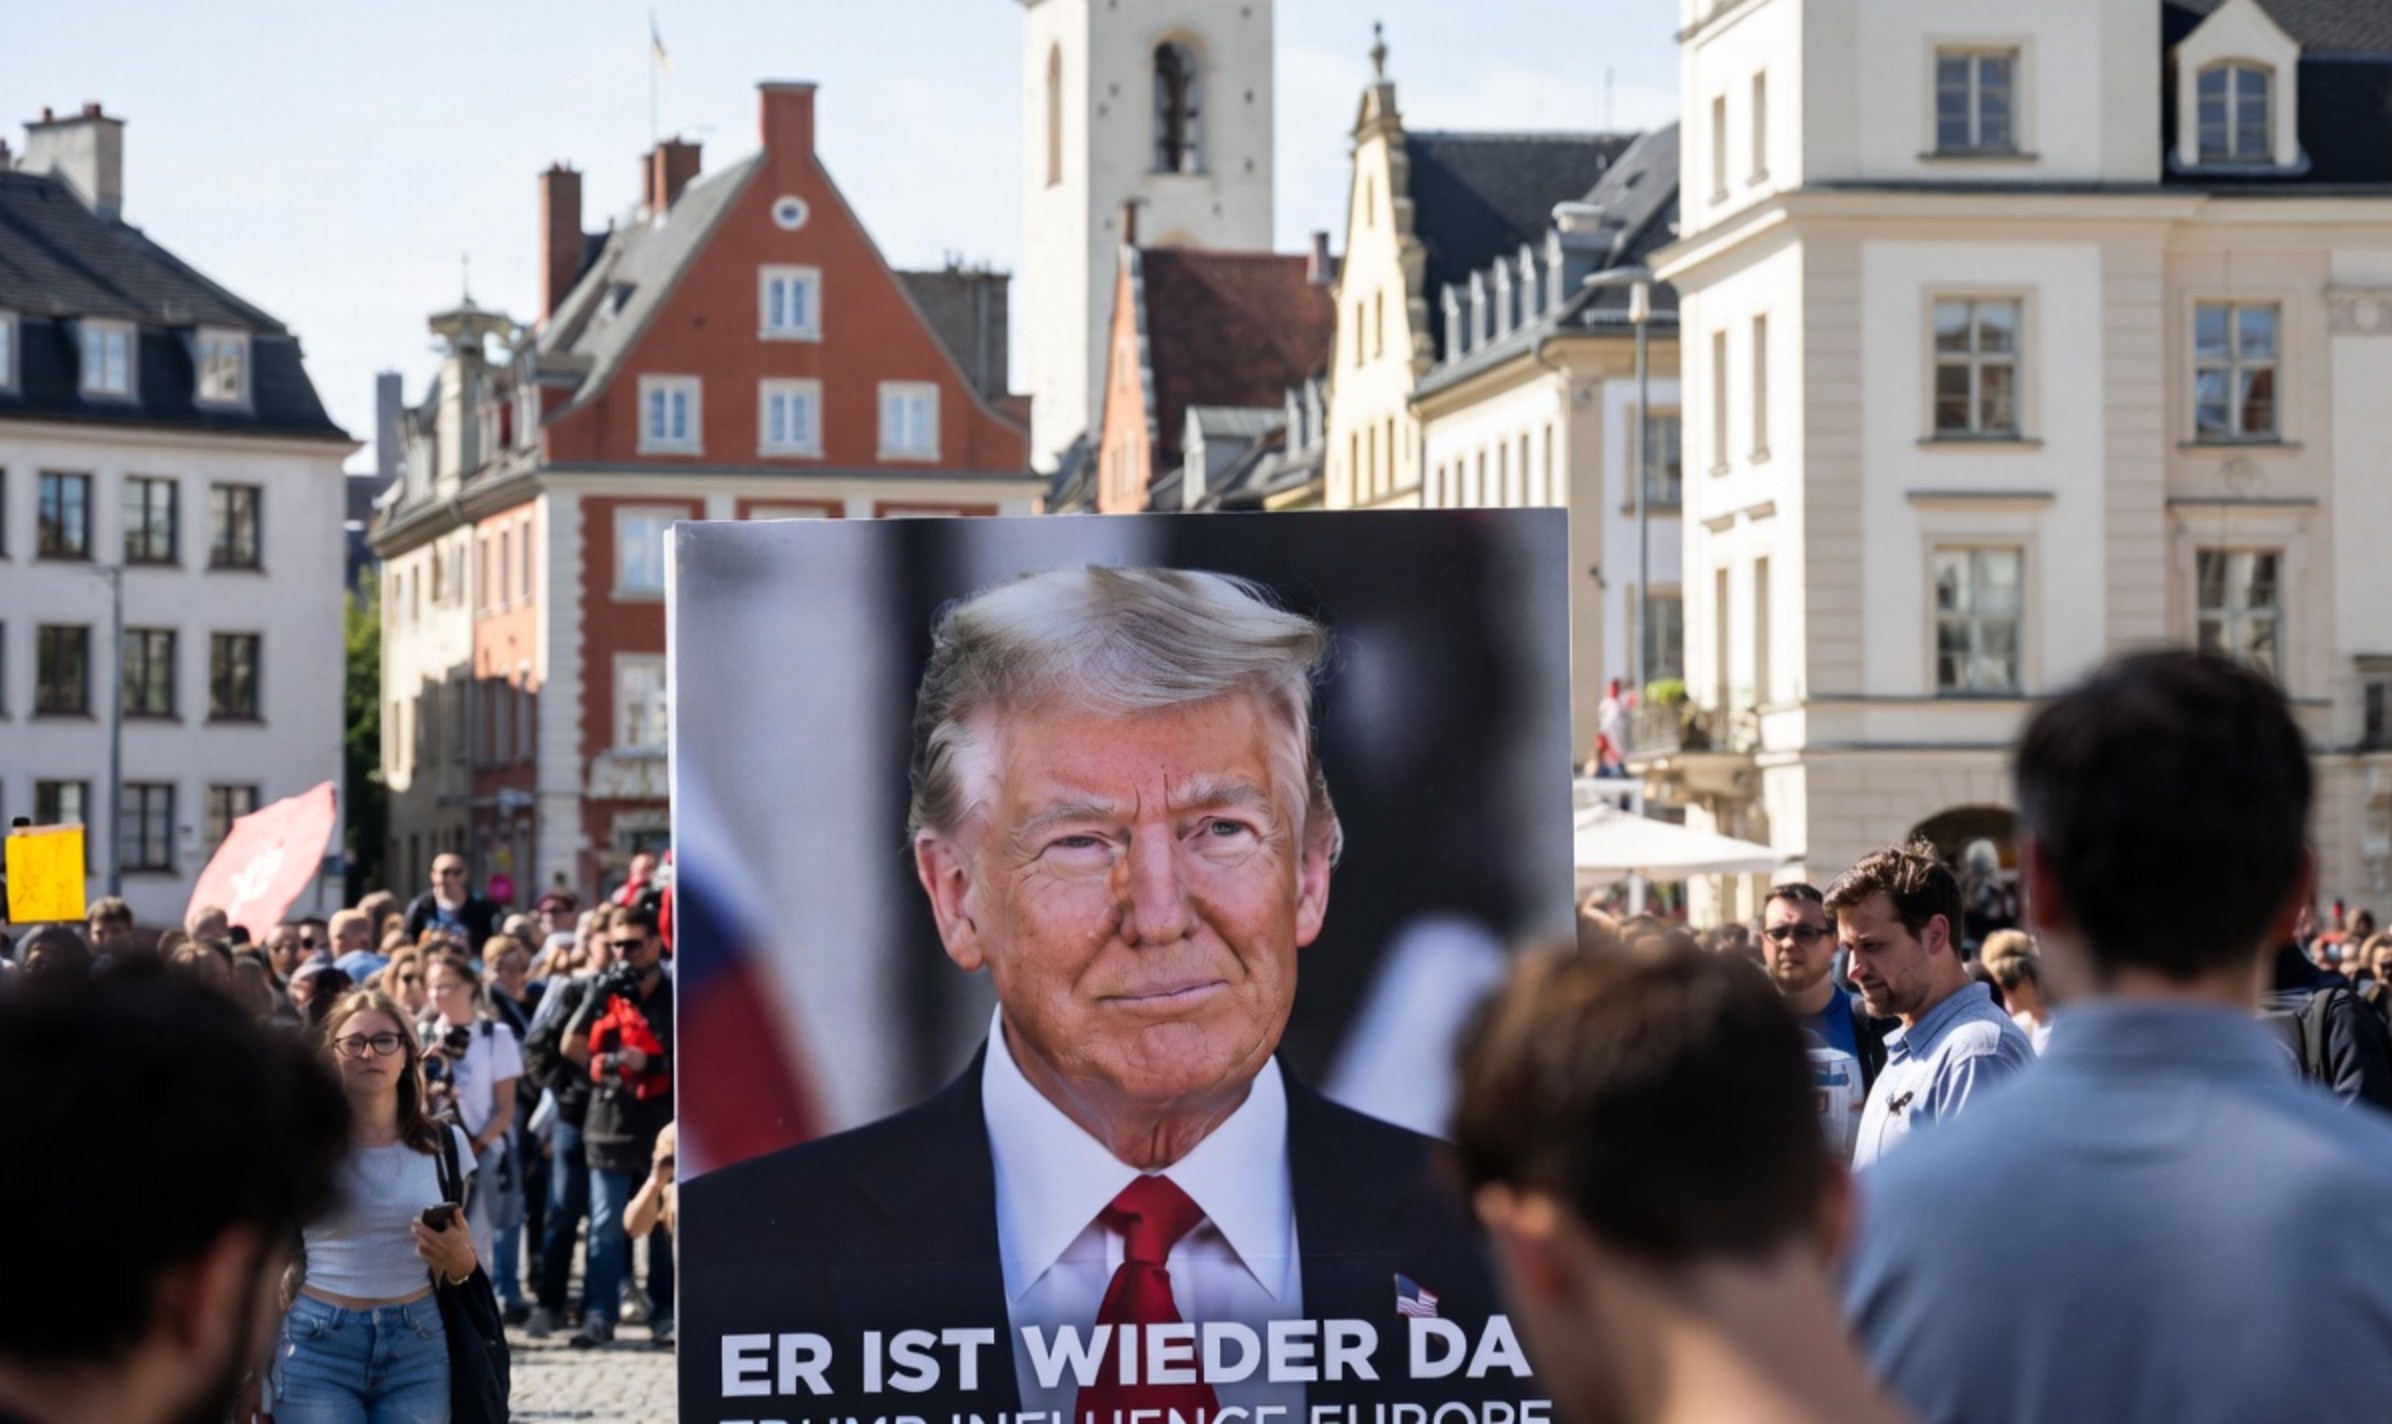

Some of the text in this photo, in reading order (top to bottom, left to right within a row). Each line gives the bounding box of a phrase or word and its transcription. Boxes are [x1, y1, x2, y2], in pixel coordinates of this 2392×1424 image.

[721, 1315, 1534, 1397] ER IST WIEDER DA
